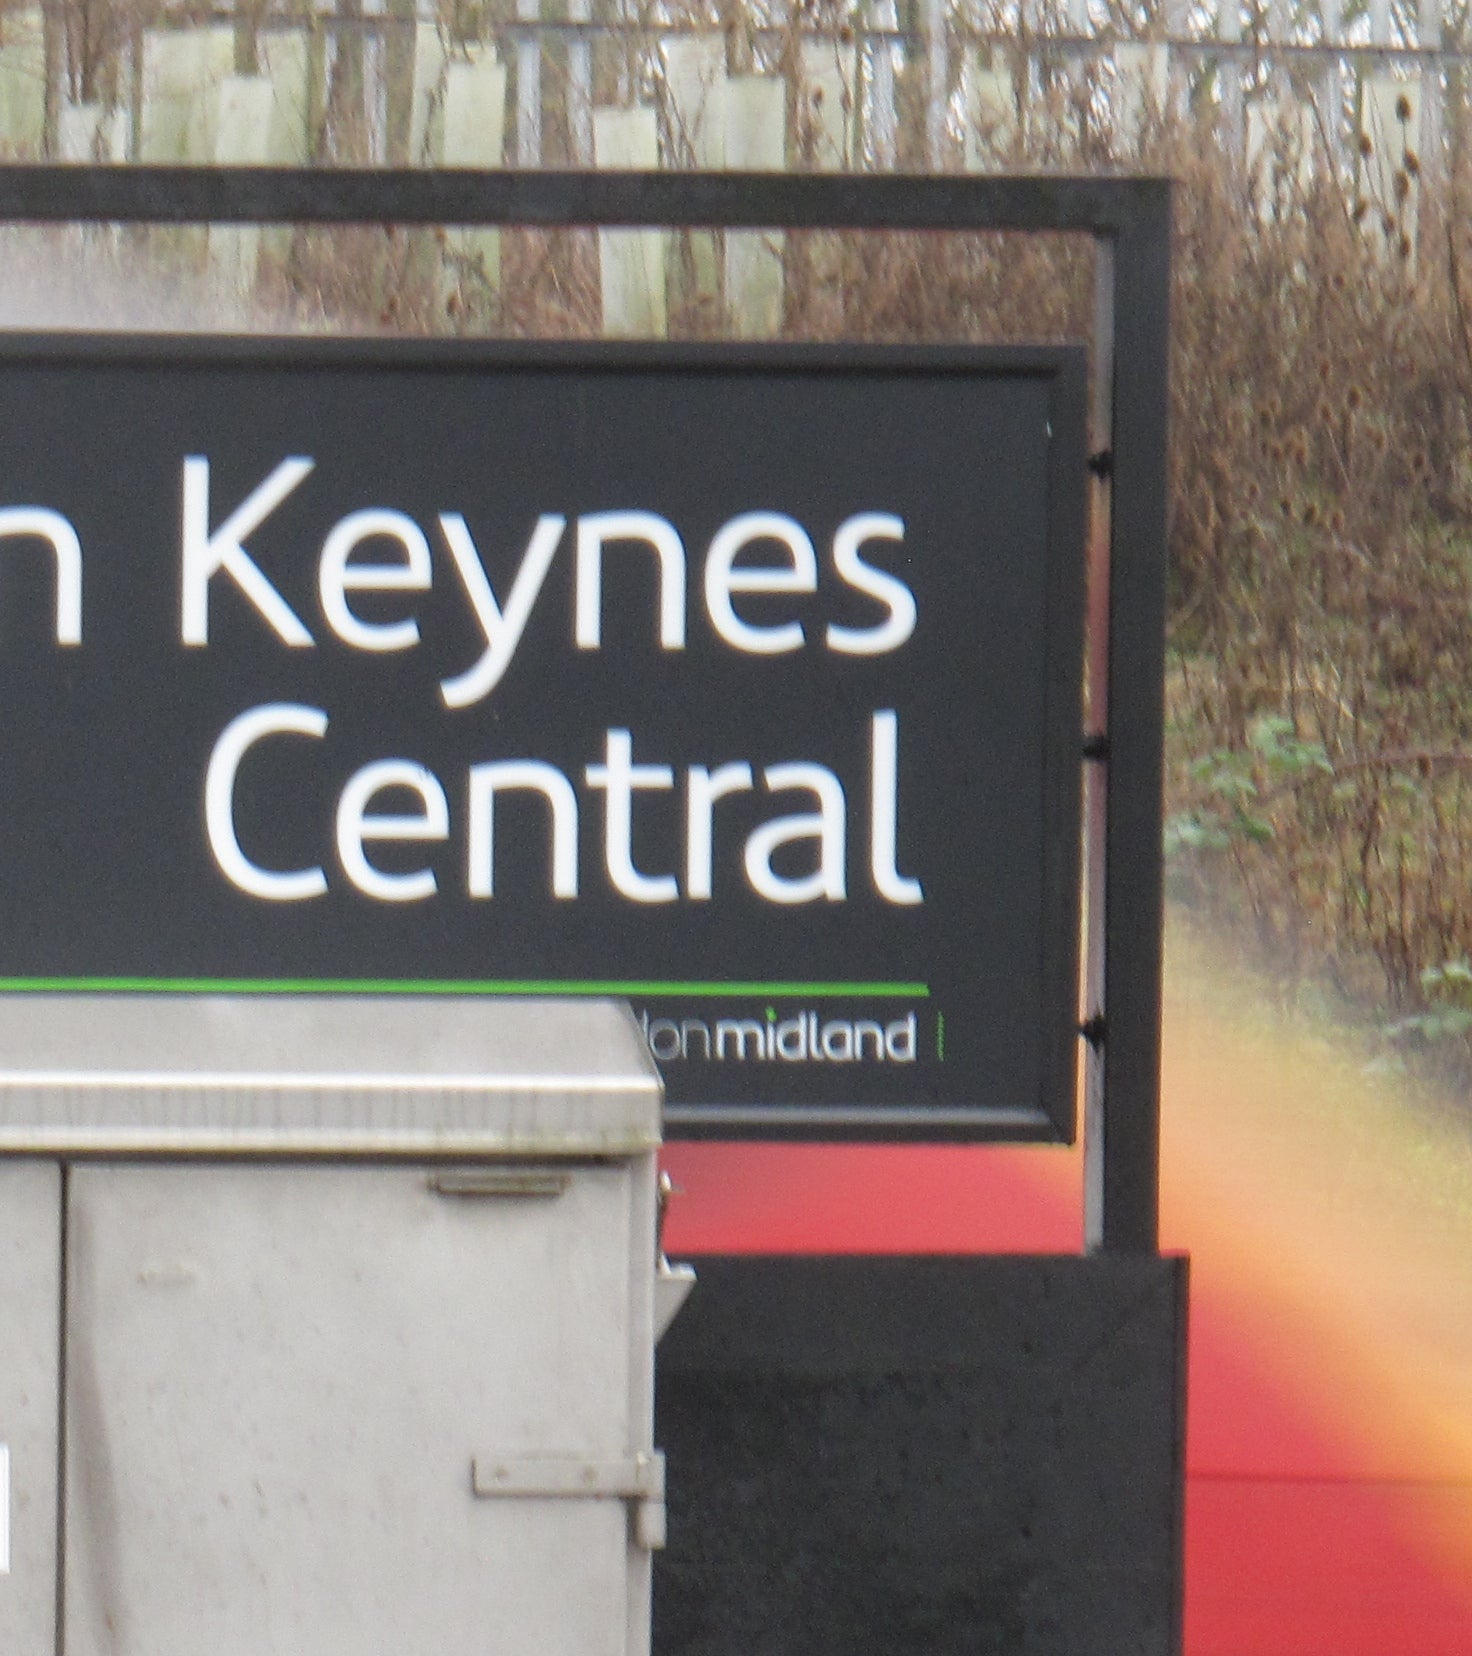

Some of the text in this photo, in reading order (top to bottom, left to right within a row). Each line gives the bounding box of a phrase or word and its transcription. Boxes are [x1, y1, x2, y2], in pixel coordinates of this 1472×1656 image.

[180, 455, 918, 709] Keynes
[203, 703, 924, 906] Central
[641, 1005, 918, 1062] onmidland
